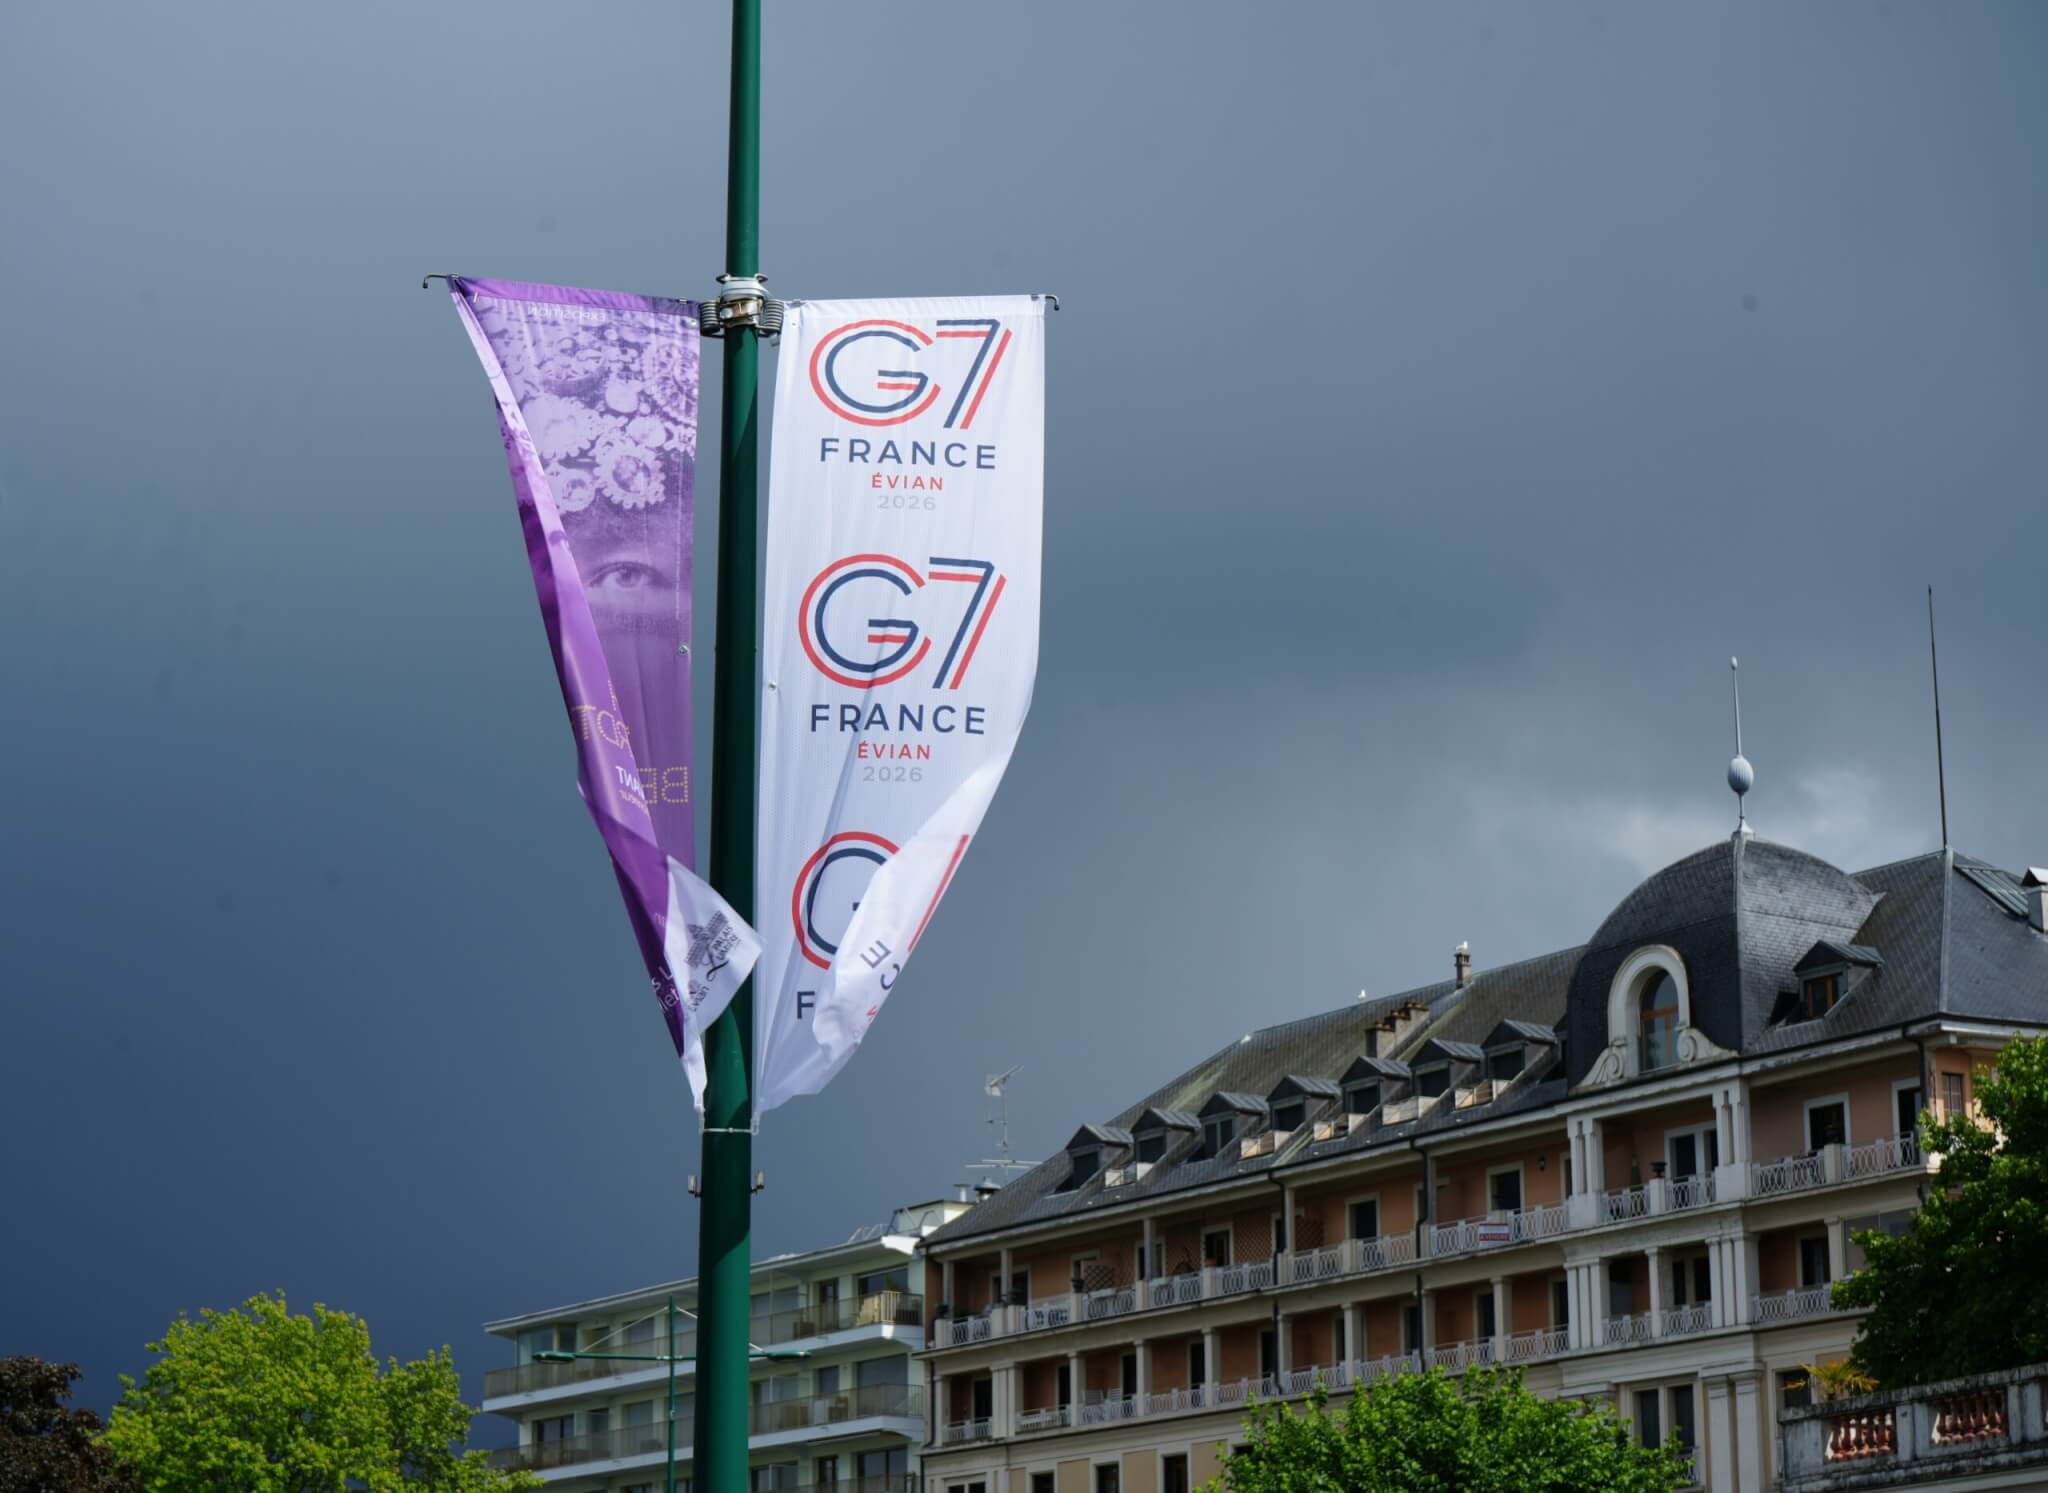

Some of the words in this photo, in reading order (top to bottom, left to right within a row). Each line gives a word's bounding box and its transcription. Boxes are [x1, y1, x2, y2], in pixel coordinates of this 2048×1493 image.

[808, 318, 1013, 430] G7
[819, 437, 996, 470] FRANCE
[871, 472, 944, 492] ÉVIAN
[877, 494, 937, 512] 2026
[797, 552, 1007, 691] G7
[810, 703, 985, 735] FRANCE
[857, 739, 931, 761] ÉVIAN
[862, 765, 923, 783] 2026
